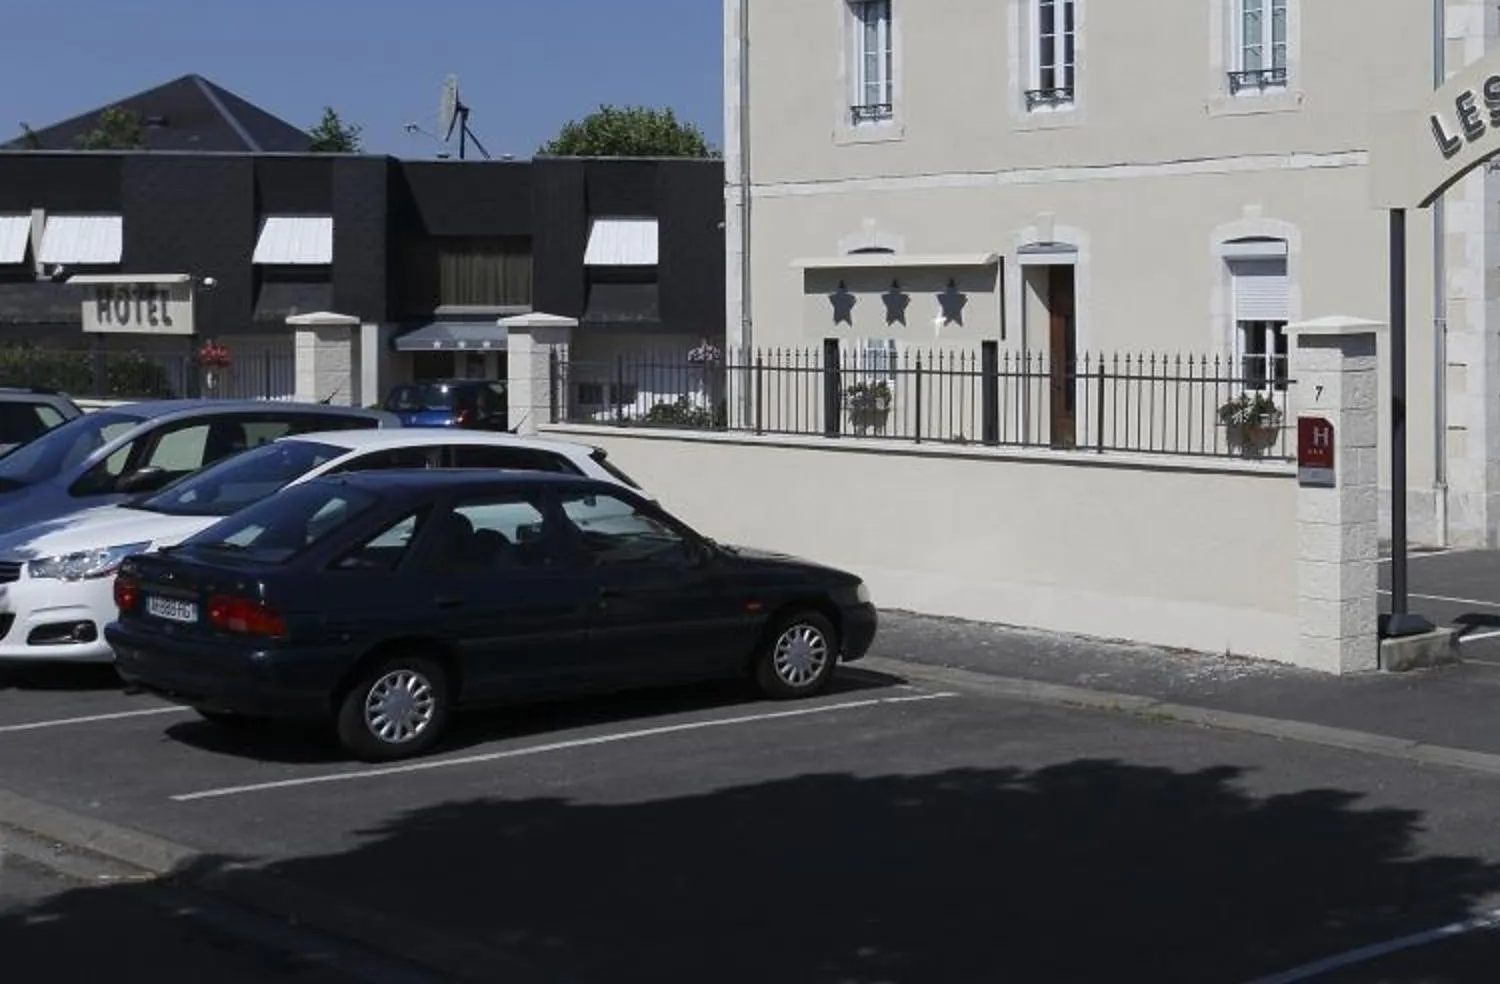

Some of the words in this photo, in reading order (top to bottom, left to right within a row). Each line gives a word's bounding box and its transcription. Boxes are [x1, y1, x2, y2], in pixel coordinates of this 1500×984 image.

[96, 283, 173, 326] HOTEL
[1313, 385, 1324, 402] 7
[1313, 427, 1329, 446] H
